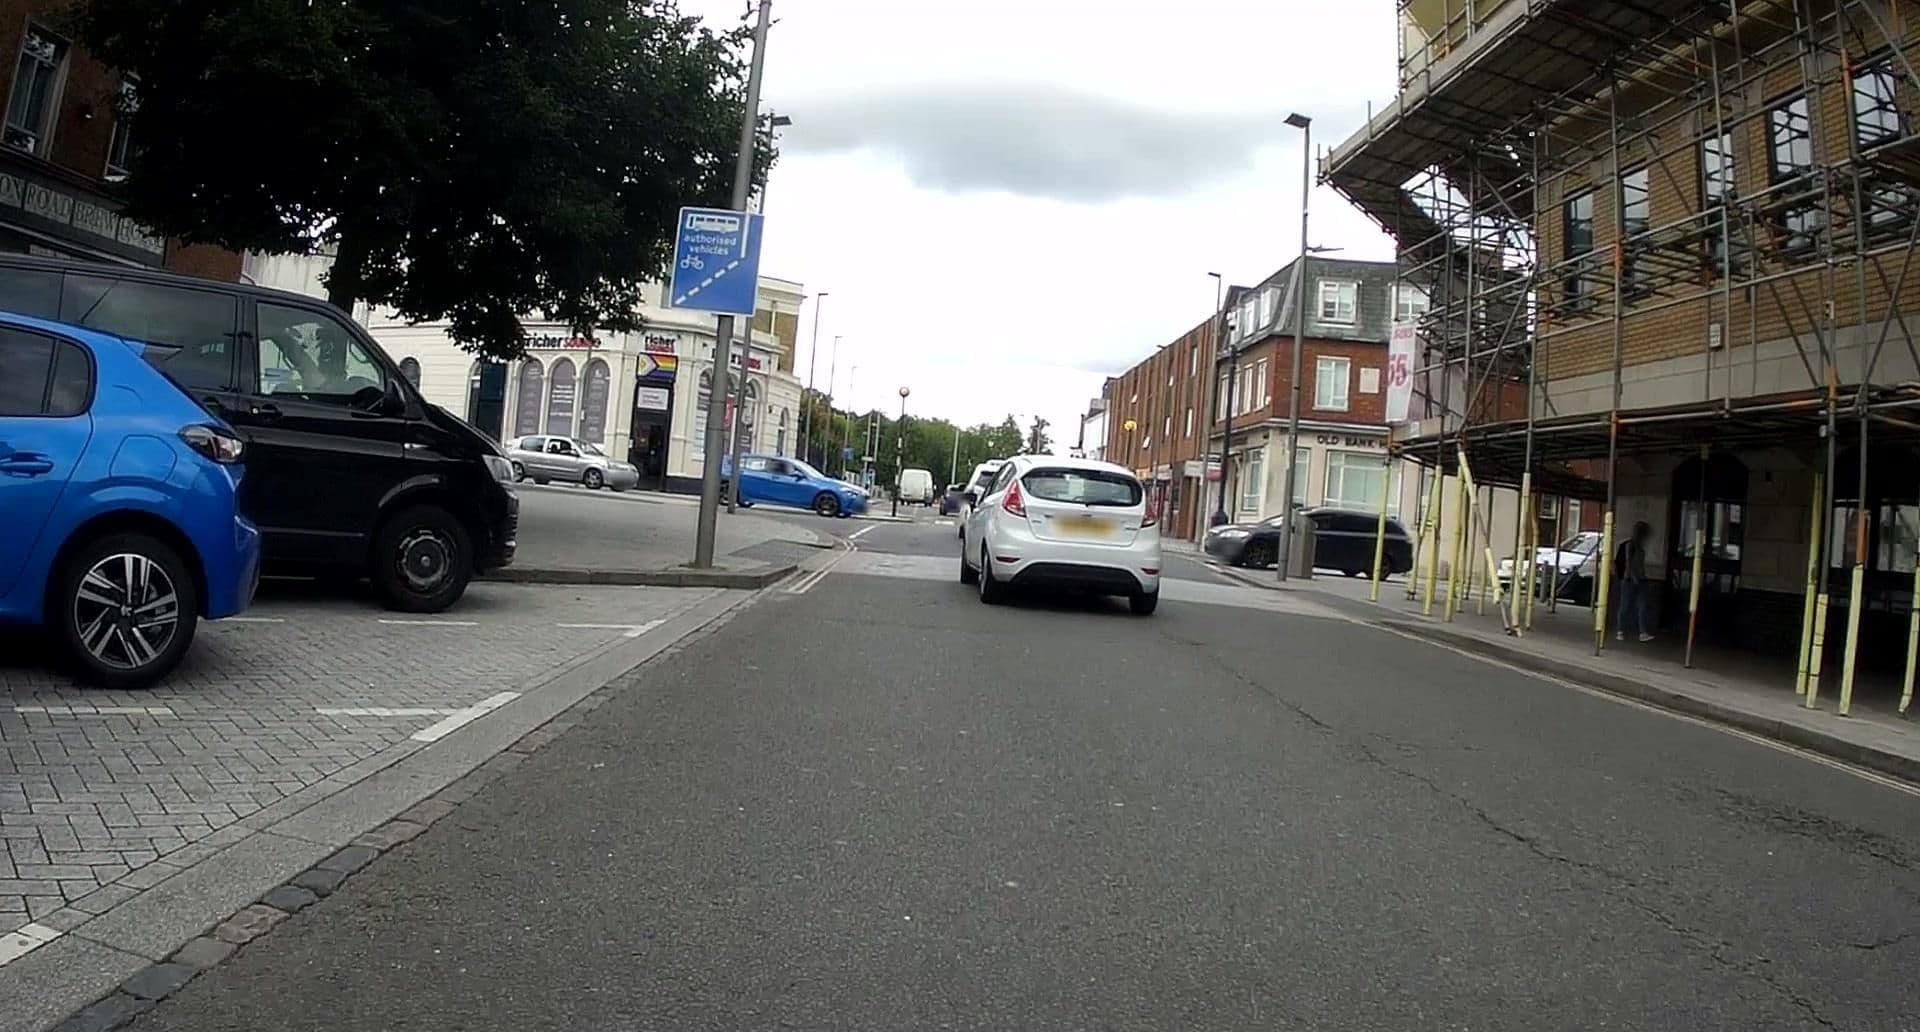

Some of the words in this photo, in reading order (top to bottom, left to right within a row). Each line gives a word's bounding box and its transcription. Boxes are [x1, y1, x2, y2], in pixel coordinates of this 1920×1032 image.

[27, 183, 73, 217] ROAD
[684, 233, 737, 246] authorised
[689, 244, 729, 256] vehicles
[527, 332, 563, 348] richer
[645, 333, 676, 346] richer
[1316, 435, 1340, 445] OLD
